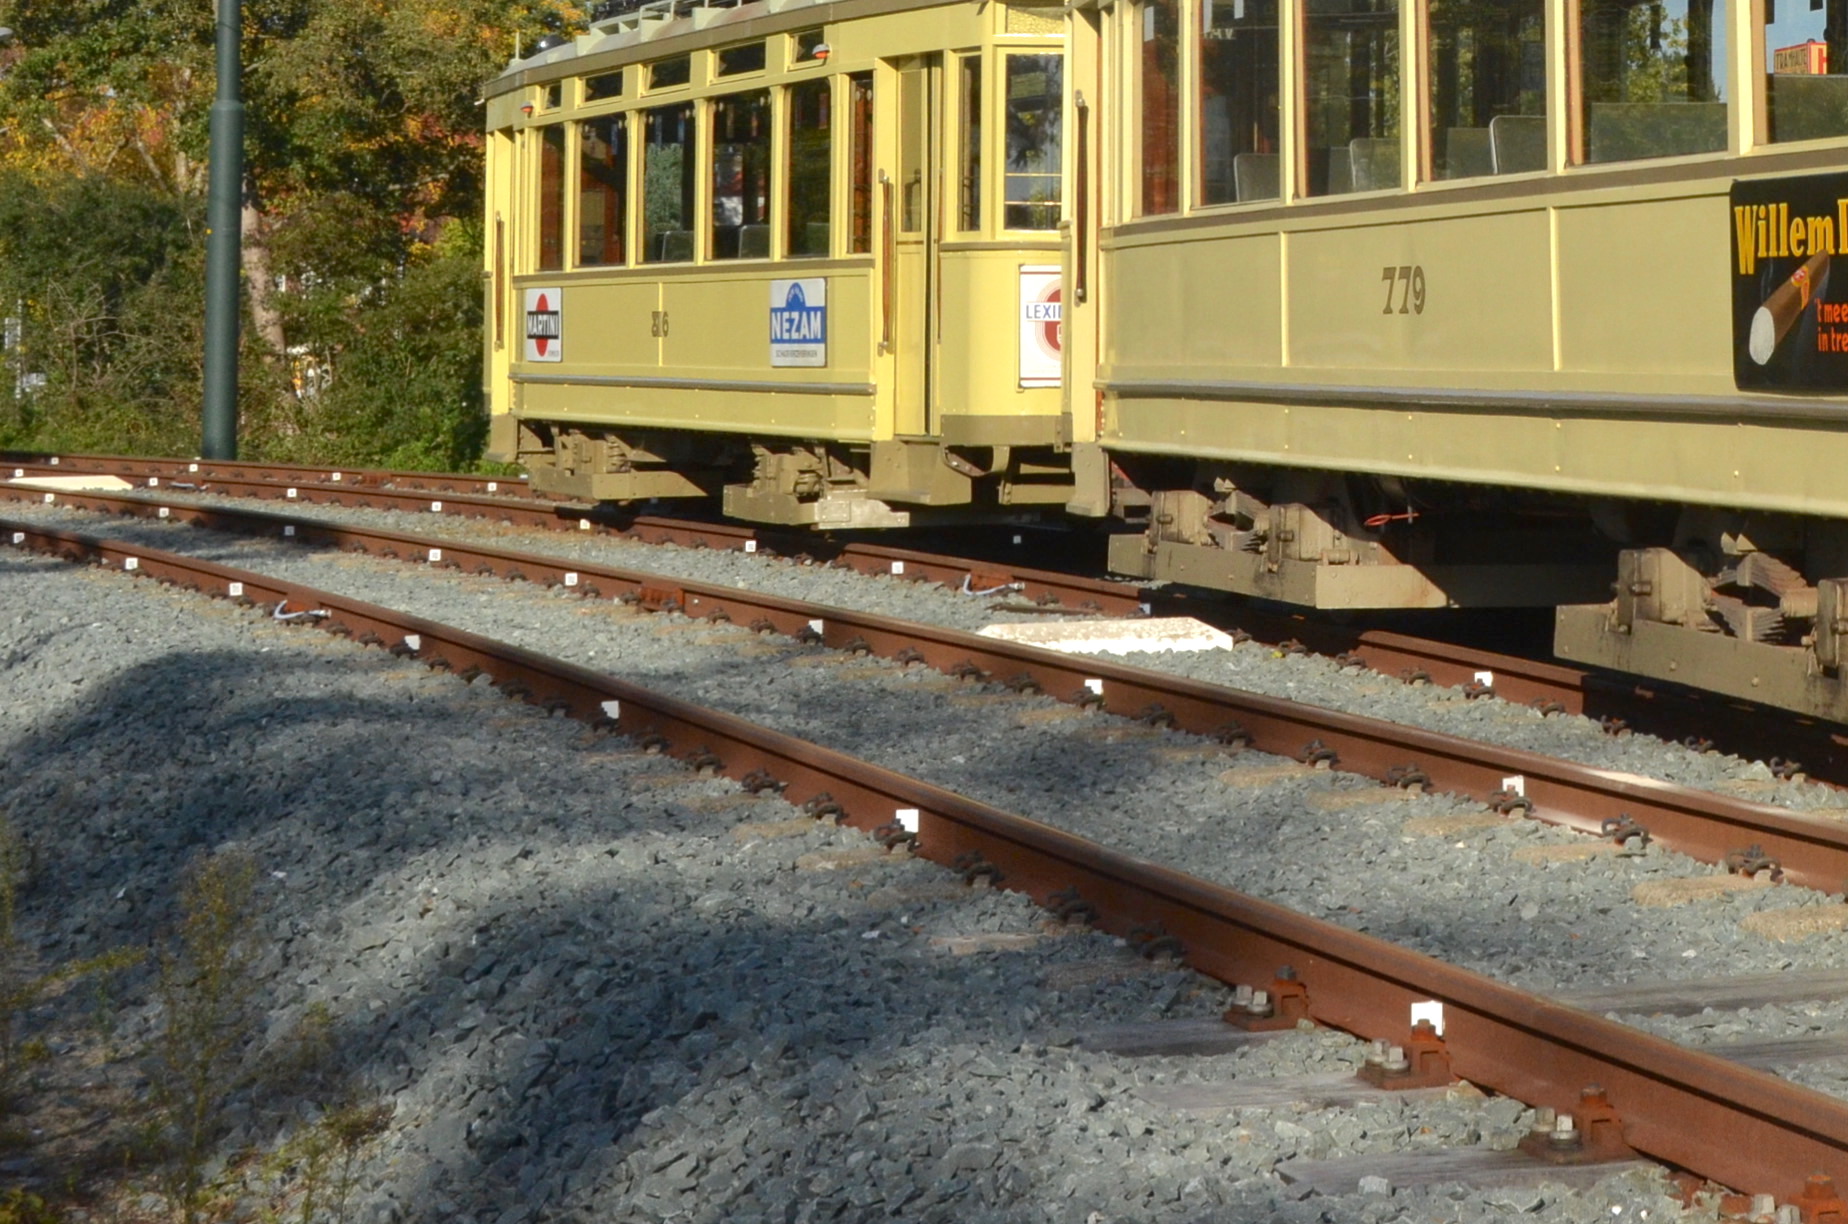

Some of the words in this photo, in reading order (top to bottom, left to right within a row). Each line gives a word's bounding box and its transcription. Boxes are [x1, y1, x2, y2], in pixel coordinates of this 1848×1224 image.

[1734, 202, 1835, 275] Willem
[1381, 265, 1426, 316] 779
[527, 314, 559, 336] MARTINI
[771, 310, 822, 340] NEZAM
[1025, 304, 1063, 320] LEXI
[1818, 326, 1829, 352] in
